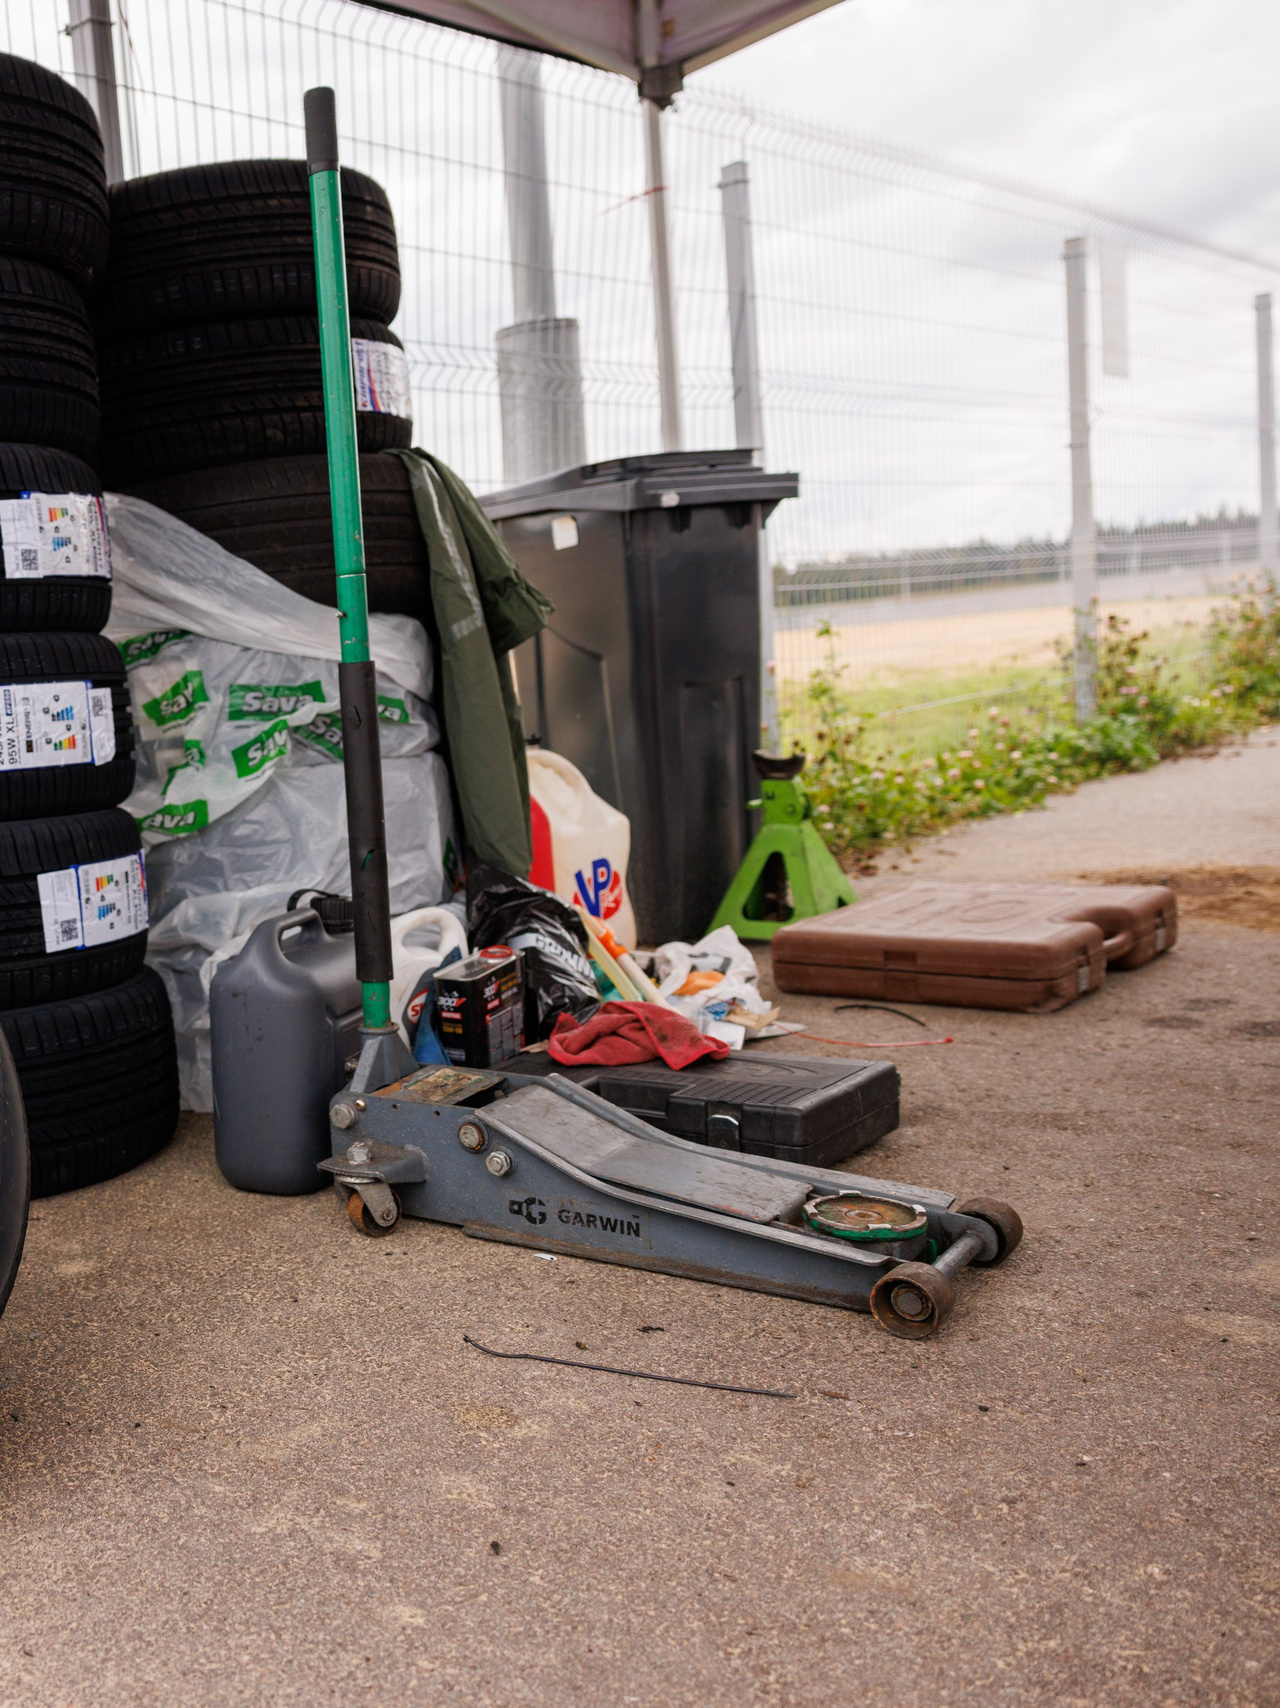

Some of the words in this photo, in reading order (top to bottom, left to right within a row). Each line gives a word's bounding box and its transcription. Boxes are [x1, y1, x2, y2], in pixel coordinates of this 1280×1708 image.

[6, 716, 17, 734] XL
[8, 739, 19, 765] 95W
[575, 858, 611, 918] VP
[438, 996, 467, 1008] 300V
[557, 1208, 641, 1238] GARWIN
